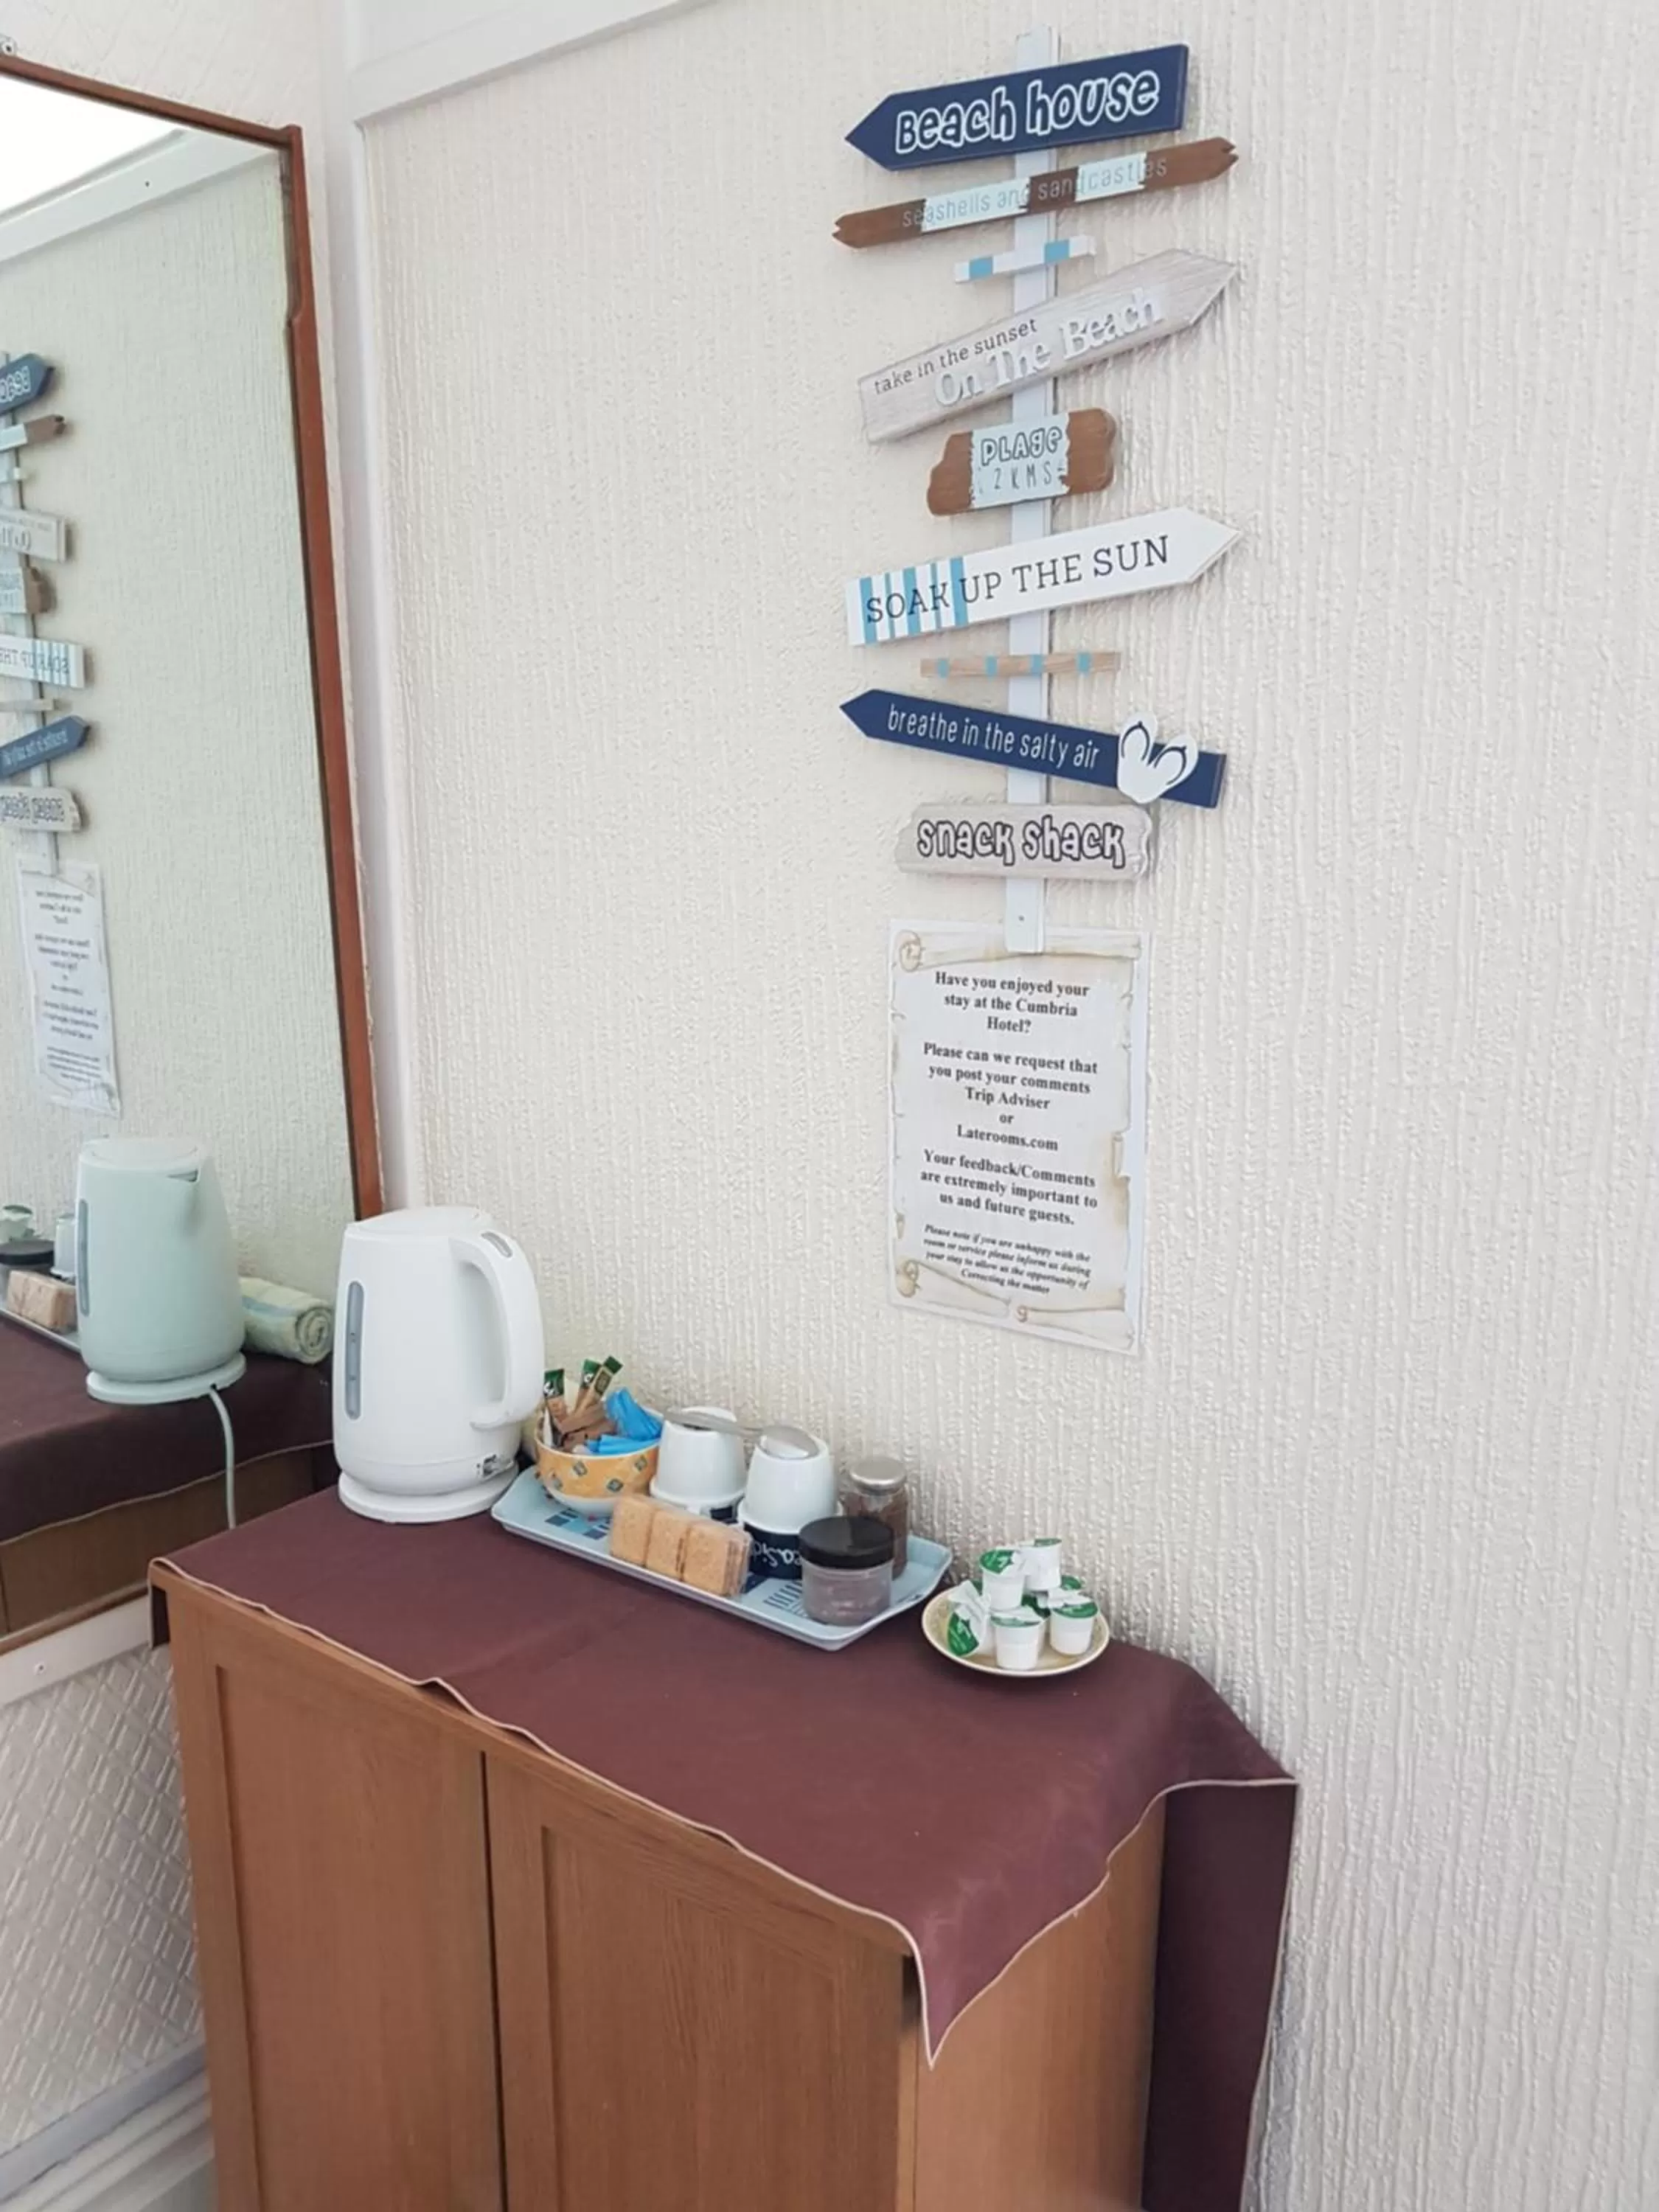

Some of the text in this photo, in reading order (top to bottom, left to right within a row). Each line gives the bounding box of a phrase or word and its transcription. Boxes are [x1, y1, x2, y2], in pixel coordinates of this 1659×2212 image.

[896, 70, 1160, 153] Beach house
[902, 190, 992, 229] seashells
[1037, 157, 1169, 201] sandcastles
[873, 319, 1037, 395] take in the sunset
[934, 290, 1166, 407] On The Beach
[866, 535, 1170, 624] SOAK UP THE SUN
[888, 704, 1099, 770] breathe in the salty air
[917, 814, 1125, 869] snack shack
[936, 971, 1091, 998] Have you enjoyed your
[944, 994, 1078, 1017] stay at the Cumbria
[987, 1015, 1032, 1034] Hotel?
[923, 1042, 1097, 1074] Please can we request that
[928, 1065, 1091, 1094] you post your comments
[964, 1086, 1051, 1110] Trip Adviser
[999, 1113, 1015, 1125] or
[957, 1124, 1059, 1150] Laterooms.com
[924, 1148, 1096, 1189] Your feedback/Comments
[920, 1170, 1098, 1209] are extremely important to
[939, 1192, 1075, 1225] us and future guests.
[925, 1224, 950, 1237] Please
[953, 1230, 970, 1240] note
[980, 1236, 996, 1245] you
[998, 1239, 1013, 1248] are
[1015, 1241, 1051, 1257] unhappy
[1054, 1248, 1074, 1259] with
[1076, 1251, 1091, 1263] the
[946, 1254, 962, 1265] stay
[964, 1256, 973, 1267] to
[1011, 1265, 1025, 1277] the
[1026, 1270, 1077, 1289] opportunity
[1079, 1279, 1091, 1291] of
[961, 1267, 1006, 1287] Correcting
[1007, 1278, 1021, 1289] the
[988, 1249, 1015, 1262] please
[1016, 1253, 1047, 1268] inform
[1060, 1262, 1092, 1279] during
